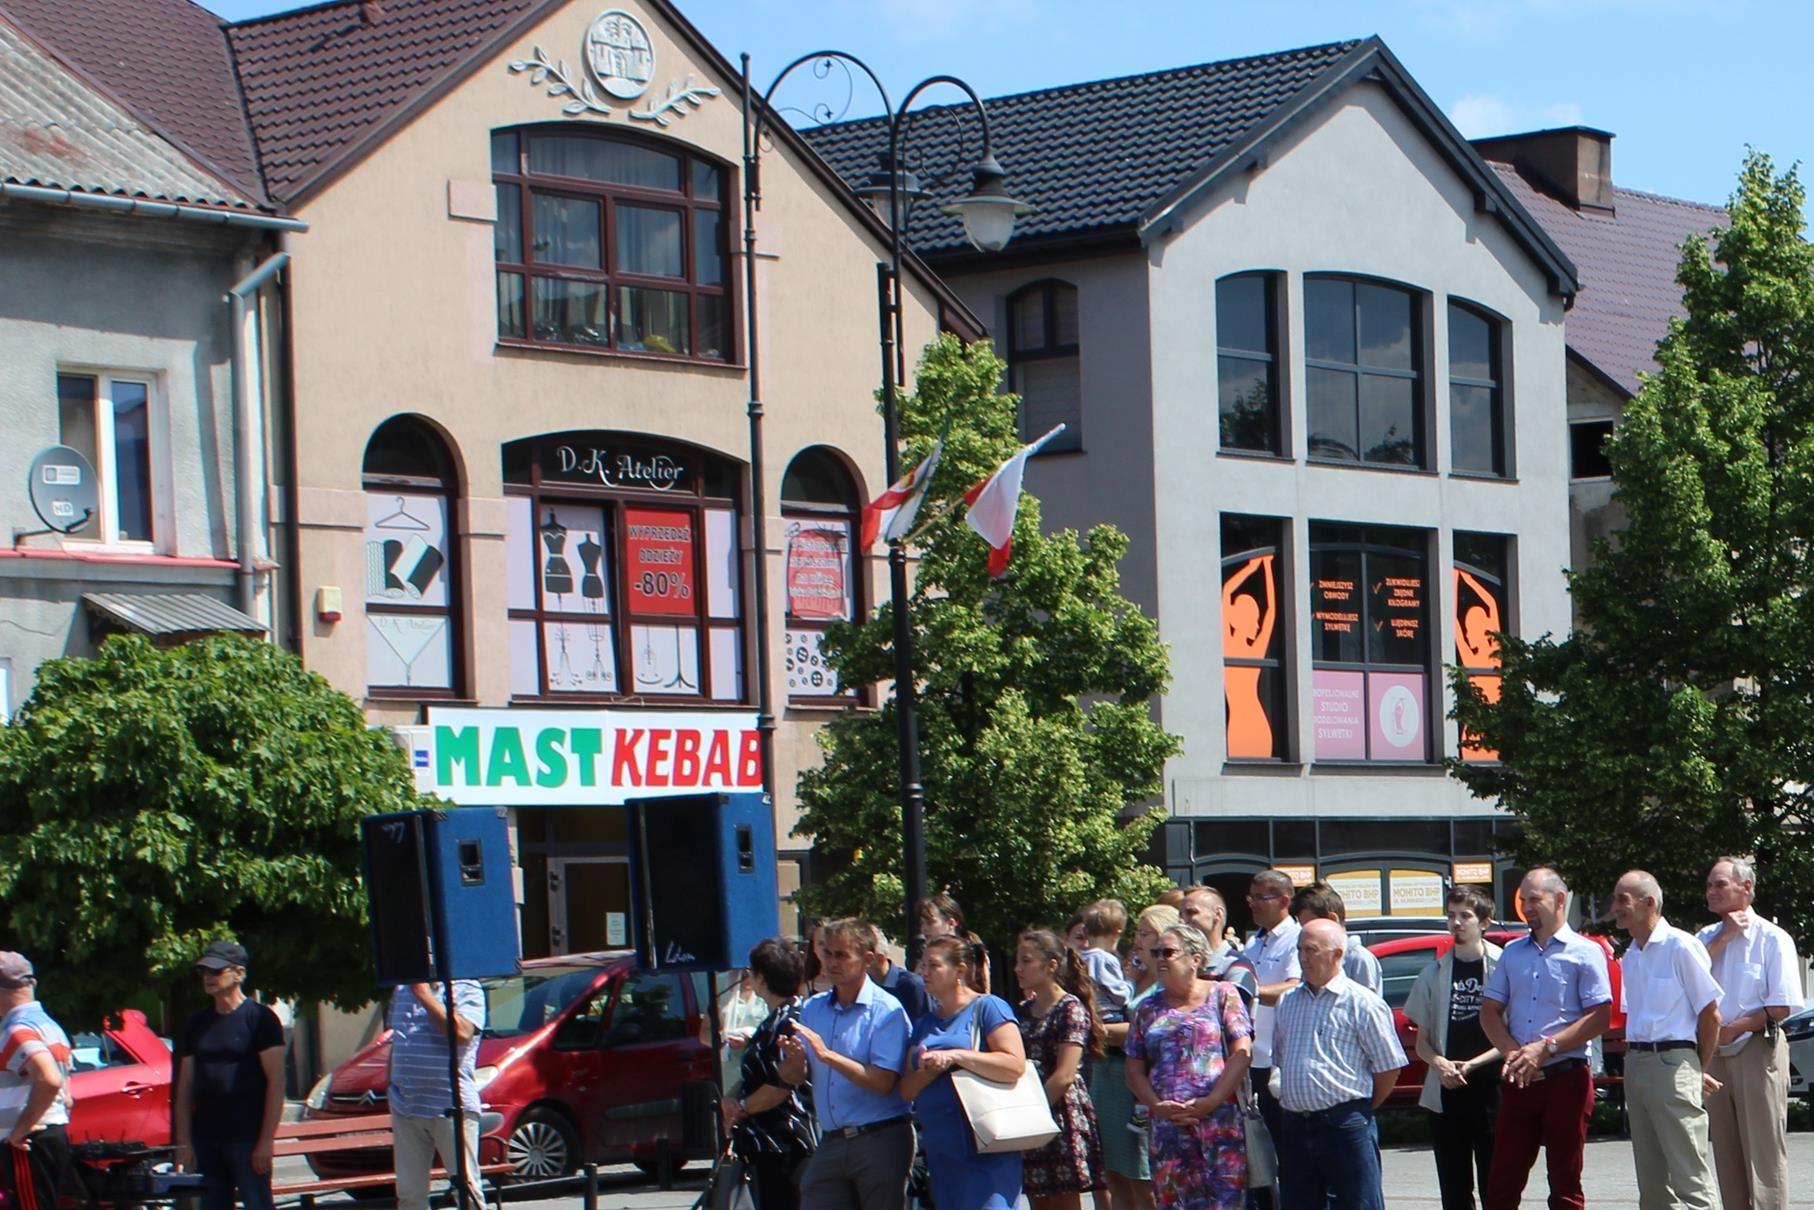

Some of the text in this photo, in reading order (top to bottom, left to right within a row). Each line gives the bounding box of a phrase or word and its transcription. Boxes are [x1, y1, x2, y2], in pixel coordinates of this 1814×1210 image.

[616, 454, 684, 491] Atelier
[628, 525, 692, 543] WYPRZEDAŻ
[639, 547, 682, 565] ODZIEŻY
[634, 571, 689, 599] -80%
[435, 725, 763, 788] MAST KEBAB
